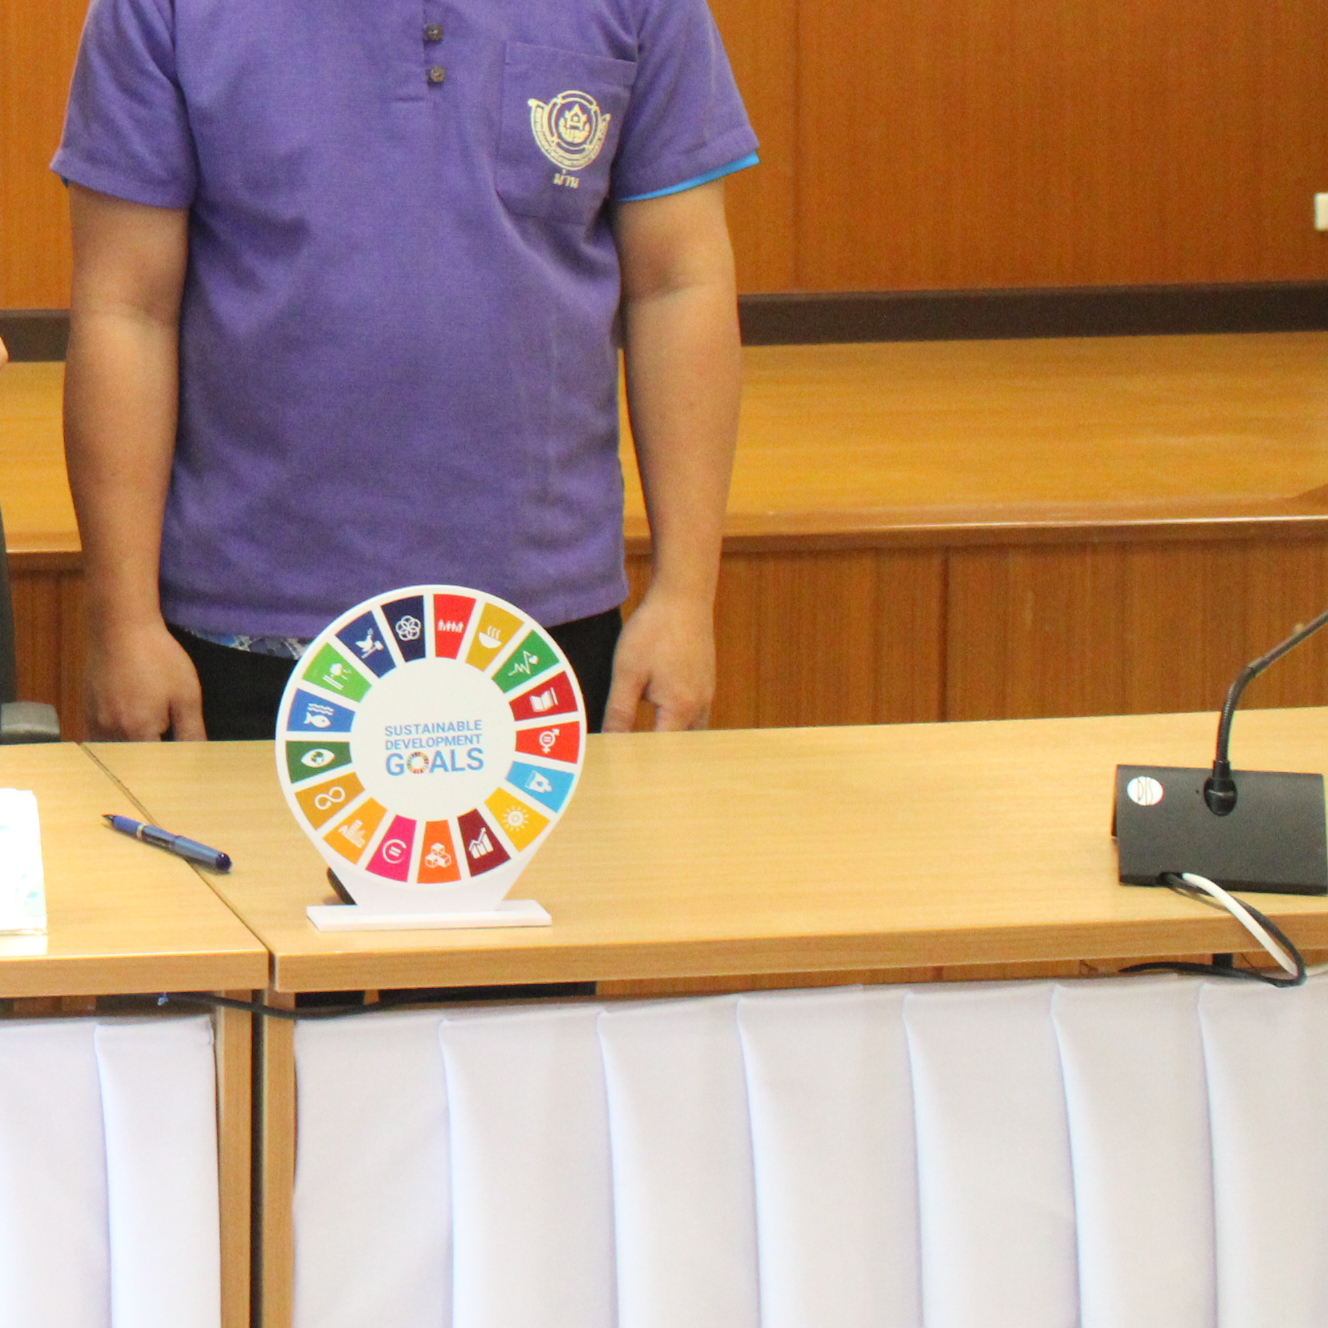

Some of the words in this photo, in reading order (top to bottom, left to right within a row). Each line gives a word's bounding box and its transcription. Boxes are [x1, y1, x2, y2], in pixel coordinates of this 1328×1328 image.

[384, 720, 483, 737] SUSTAINABLE
[384, 734, 483, 751] DEVELOPMENT
[385, 747, 485, 777] GOALS
